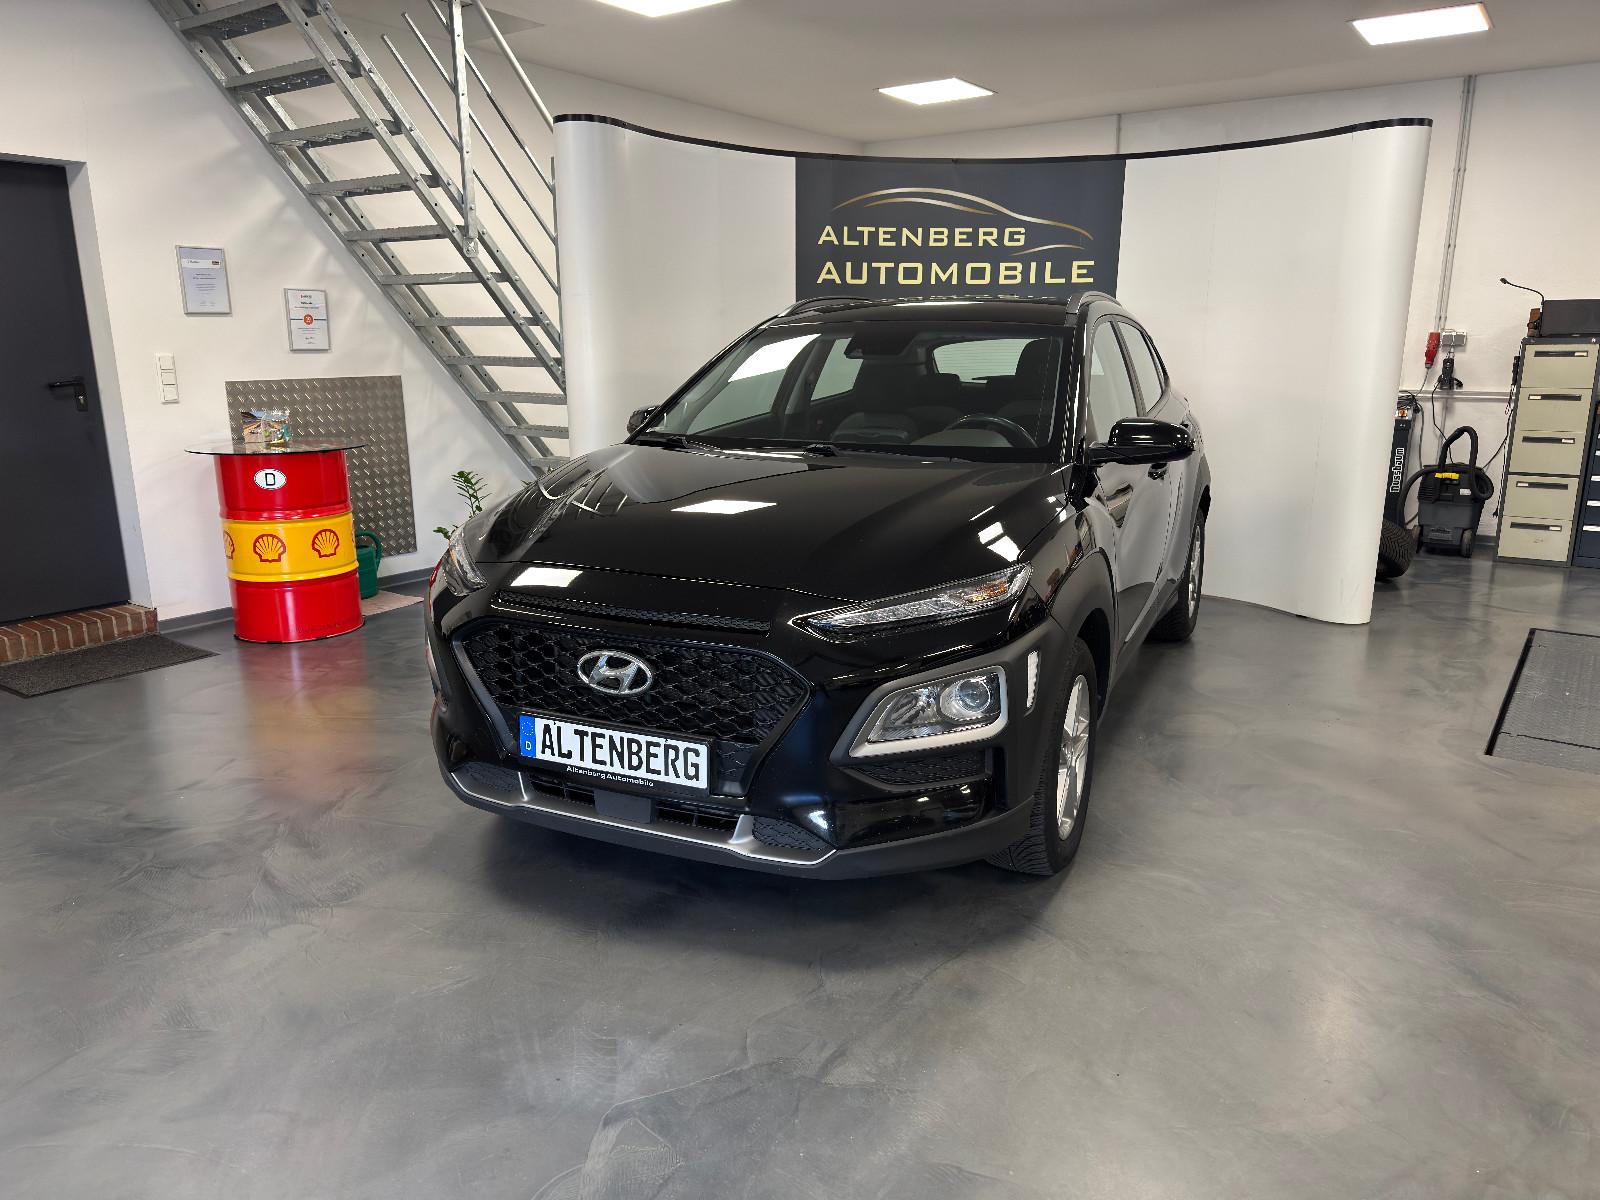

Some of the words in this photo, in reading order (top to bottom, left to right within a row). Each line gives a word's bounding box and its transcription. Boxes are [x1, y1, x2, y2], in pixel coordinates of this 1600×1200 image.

[817, 225, 1026, 248] ALTENBERG
[816, 260, 1096, 285] AUTOMOBILE
[264, 472, 276, 486] D
[525, 740, 532, 751] D
[540, 723, 701, 782] ALTENBERG
[566, 765, 606, 780] Altenberg
